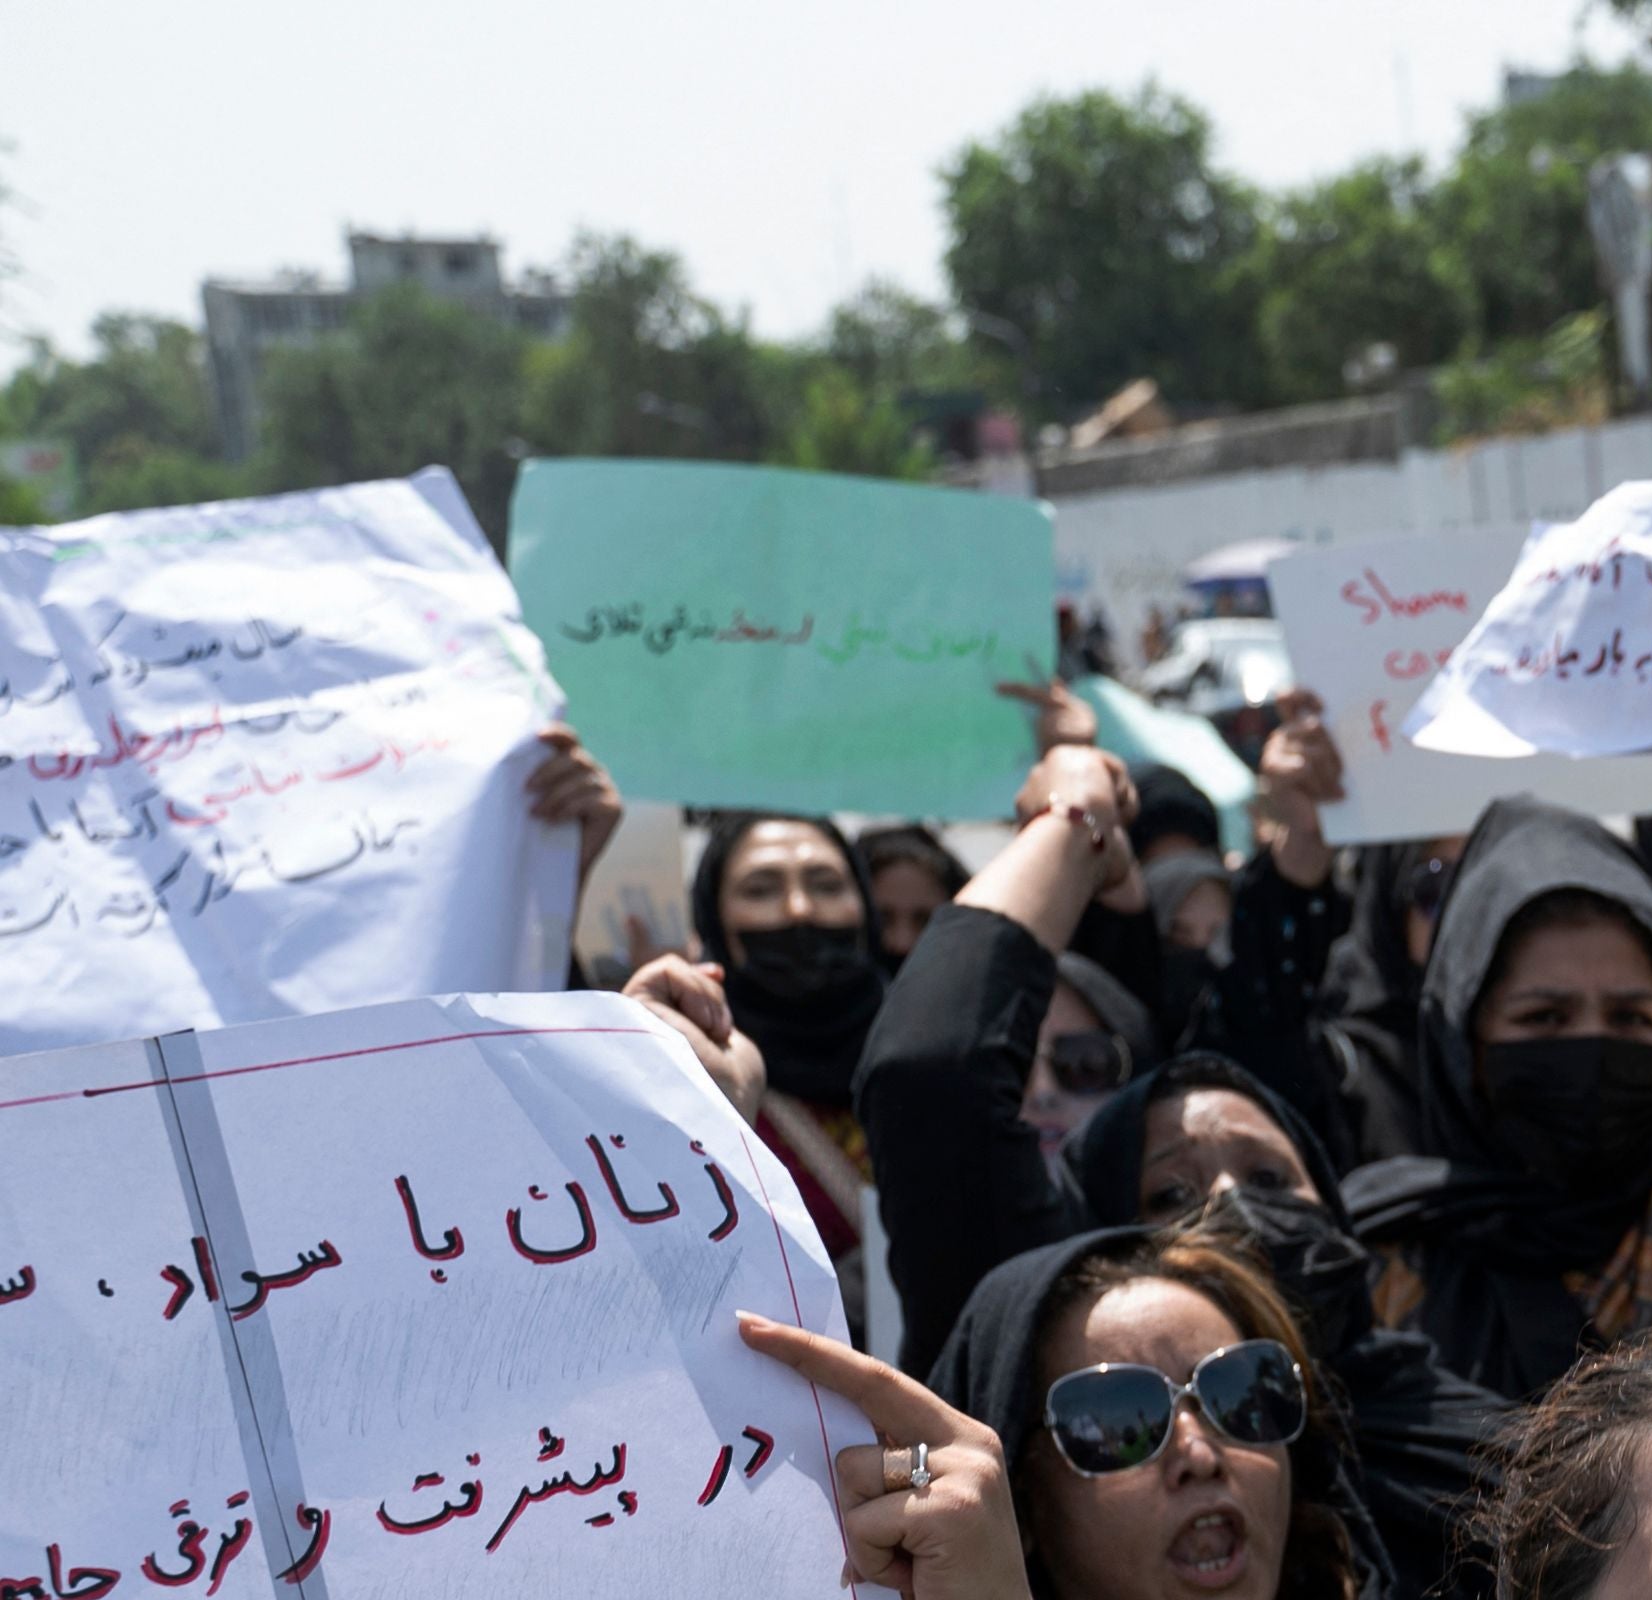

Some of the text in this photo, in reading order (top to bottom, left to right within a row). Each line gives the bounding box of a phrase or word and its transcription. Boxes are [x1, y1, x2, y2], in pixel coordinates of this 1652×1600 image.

[397, 1174, 465, 1283] با
[507, 1130, 741, 1264] زنان
[376, 1426, 640, 1554] پیشرفت
[697, 1425, 775, 1508] در
[275, 1502, 332, 1584] و
